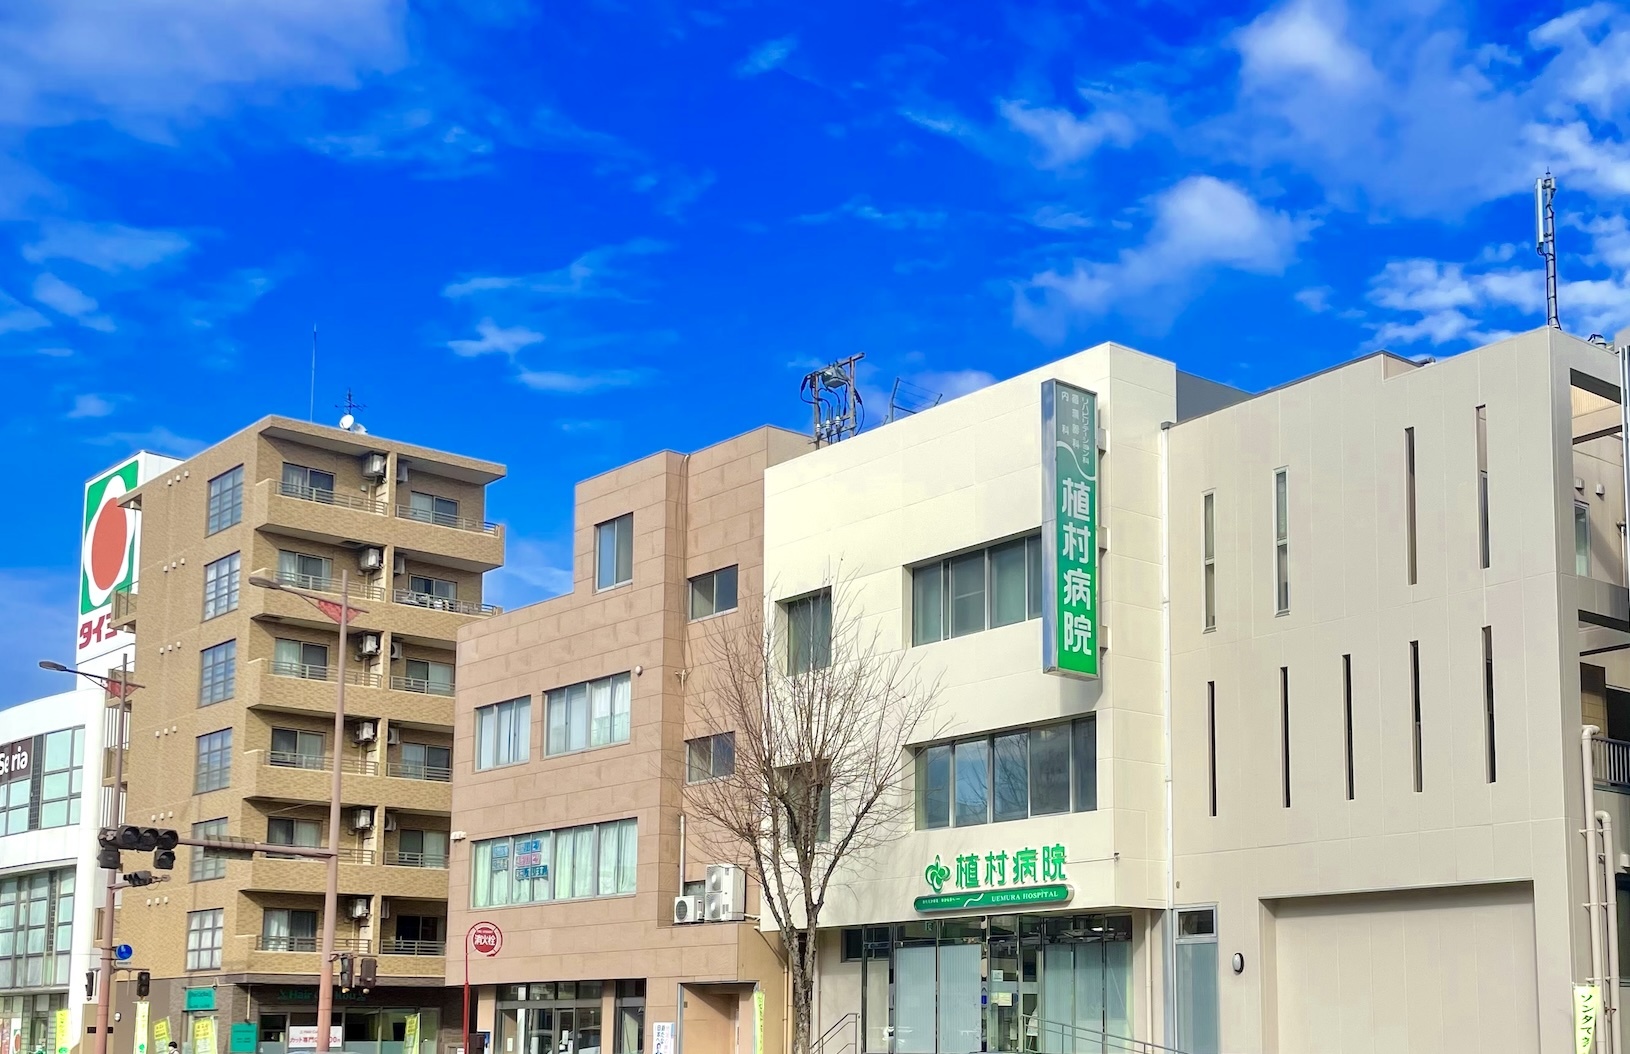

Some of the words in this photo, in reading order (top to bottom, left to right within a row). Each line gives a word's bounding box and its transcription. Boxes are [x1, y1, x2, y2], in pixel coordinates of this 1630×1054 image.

[1062, 477, 1092, 656] 植村病院
[955, 843, 1068, 889] 植村病院
[991, 893, 1021, 902] UEMURA
[1022, 889, 1059, 900] HOSPITAL
[474, 934, 497, 946] 消火栓
